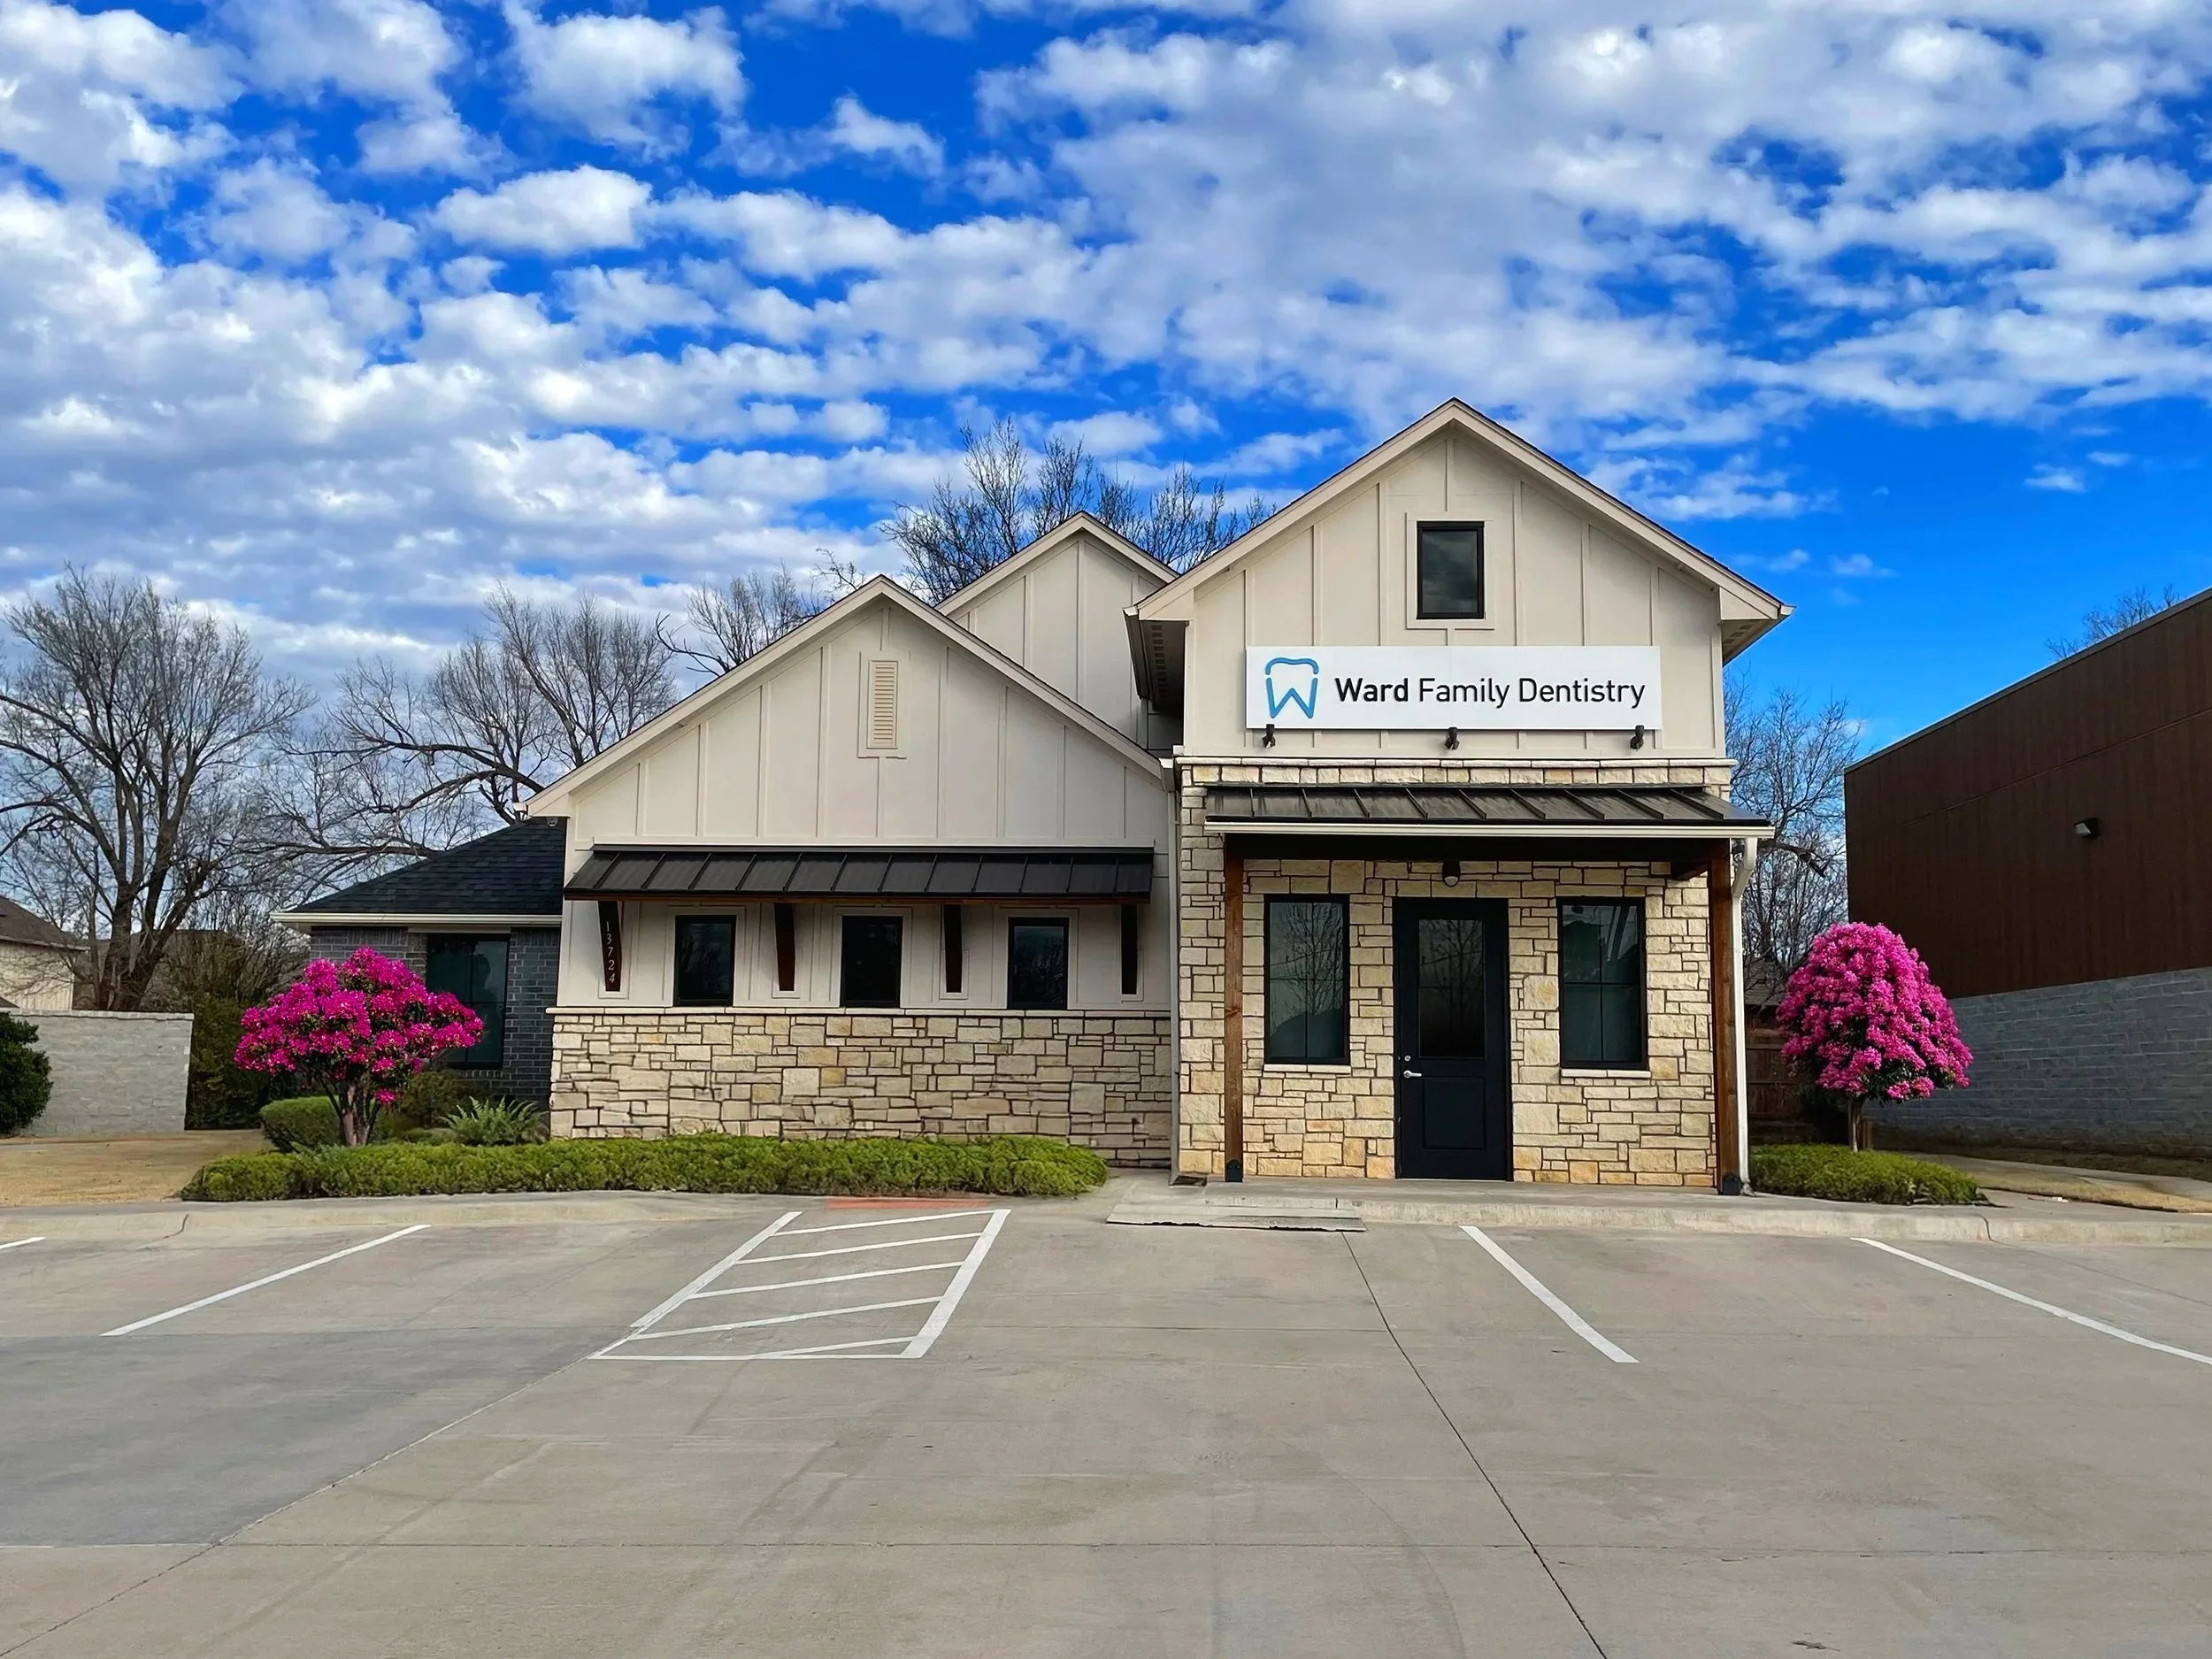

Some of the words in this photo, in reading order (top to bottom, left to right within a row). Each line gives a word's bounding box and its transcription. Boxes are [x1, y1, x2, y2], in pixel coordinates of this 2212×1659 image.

[1334, 677, 1409, 703] Ward
[1419, 677, 1510, 710] Family
[1518, 677, 1646, 710] Dentistry
[606, 921, 616, 983] 13724
